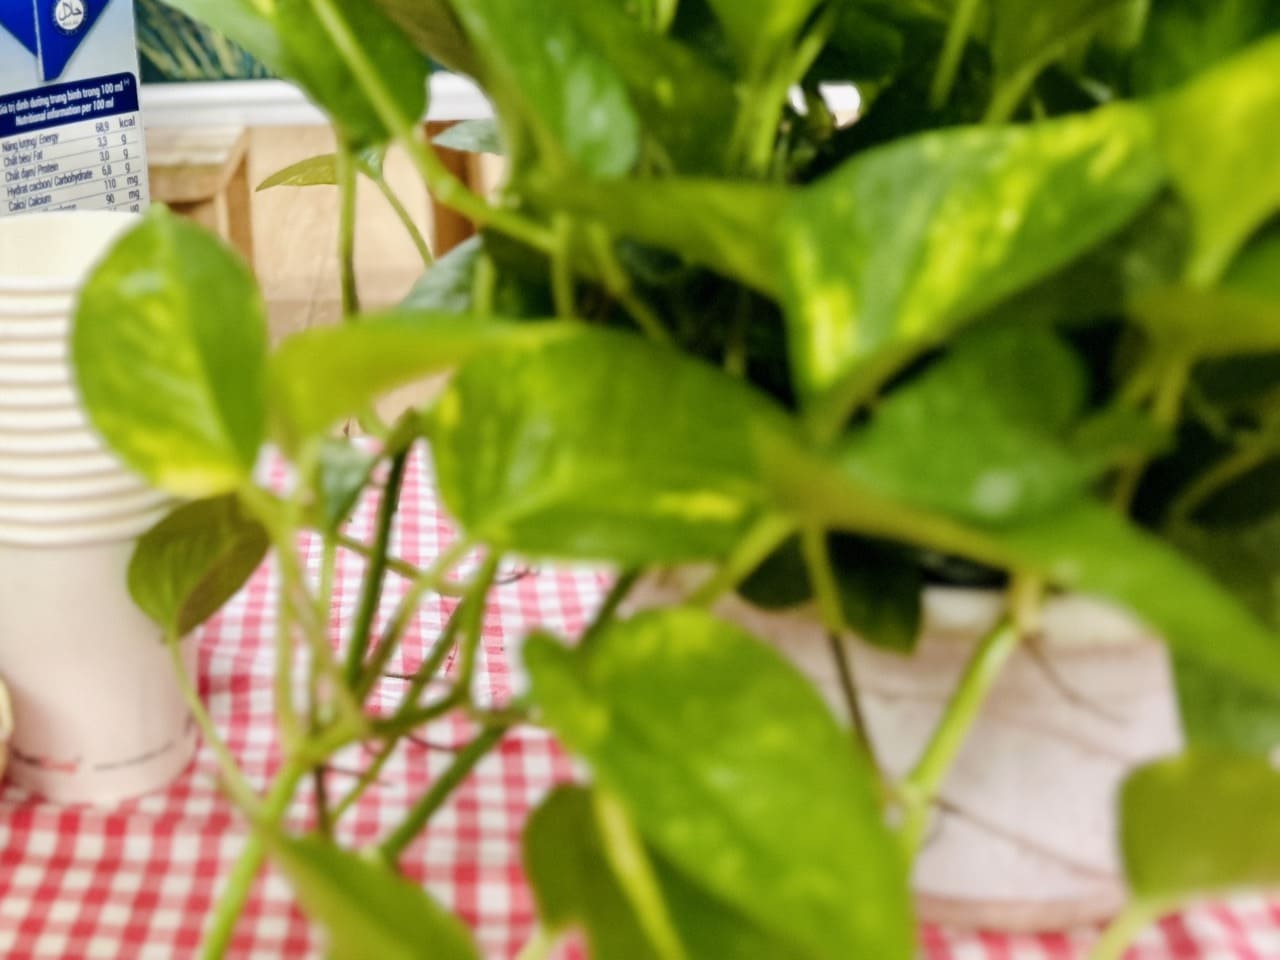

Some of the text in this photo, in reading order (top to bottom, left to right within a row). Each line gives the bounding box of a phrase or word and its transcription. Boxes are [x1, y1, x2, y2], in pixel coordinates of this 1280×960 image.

[101, 83, 114, 94] 100
[81, 103, 92, 116] per
[93, 98, 105, 111] 100
[119, 116, 136, 128] kcal
[121, 134, 127, 146] g
[123, 149, 129, 160] g
[125, 162, 131, 174] g
[104, 178, 117, 190] 110
[126, 175, 139, 187] mg
[128, 190, 141, 201] mg
